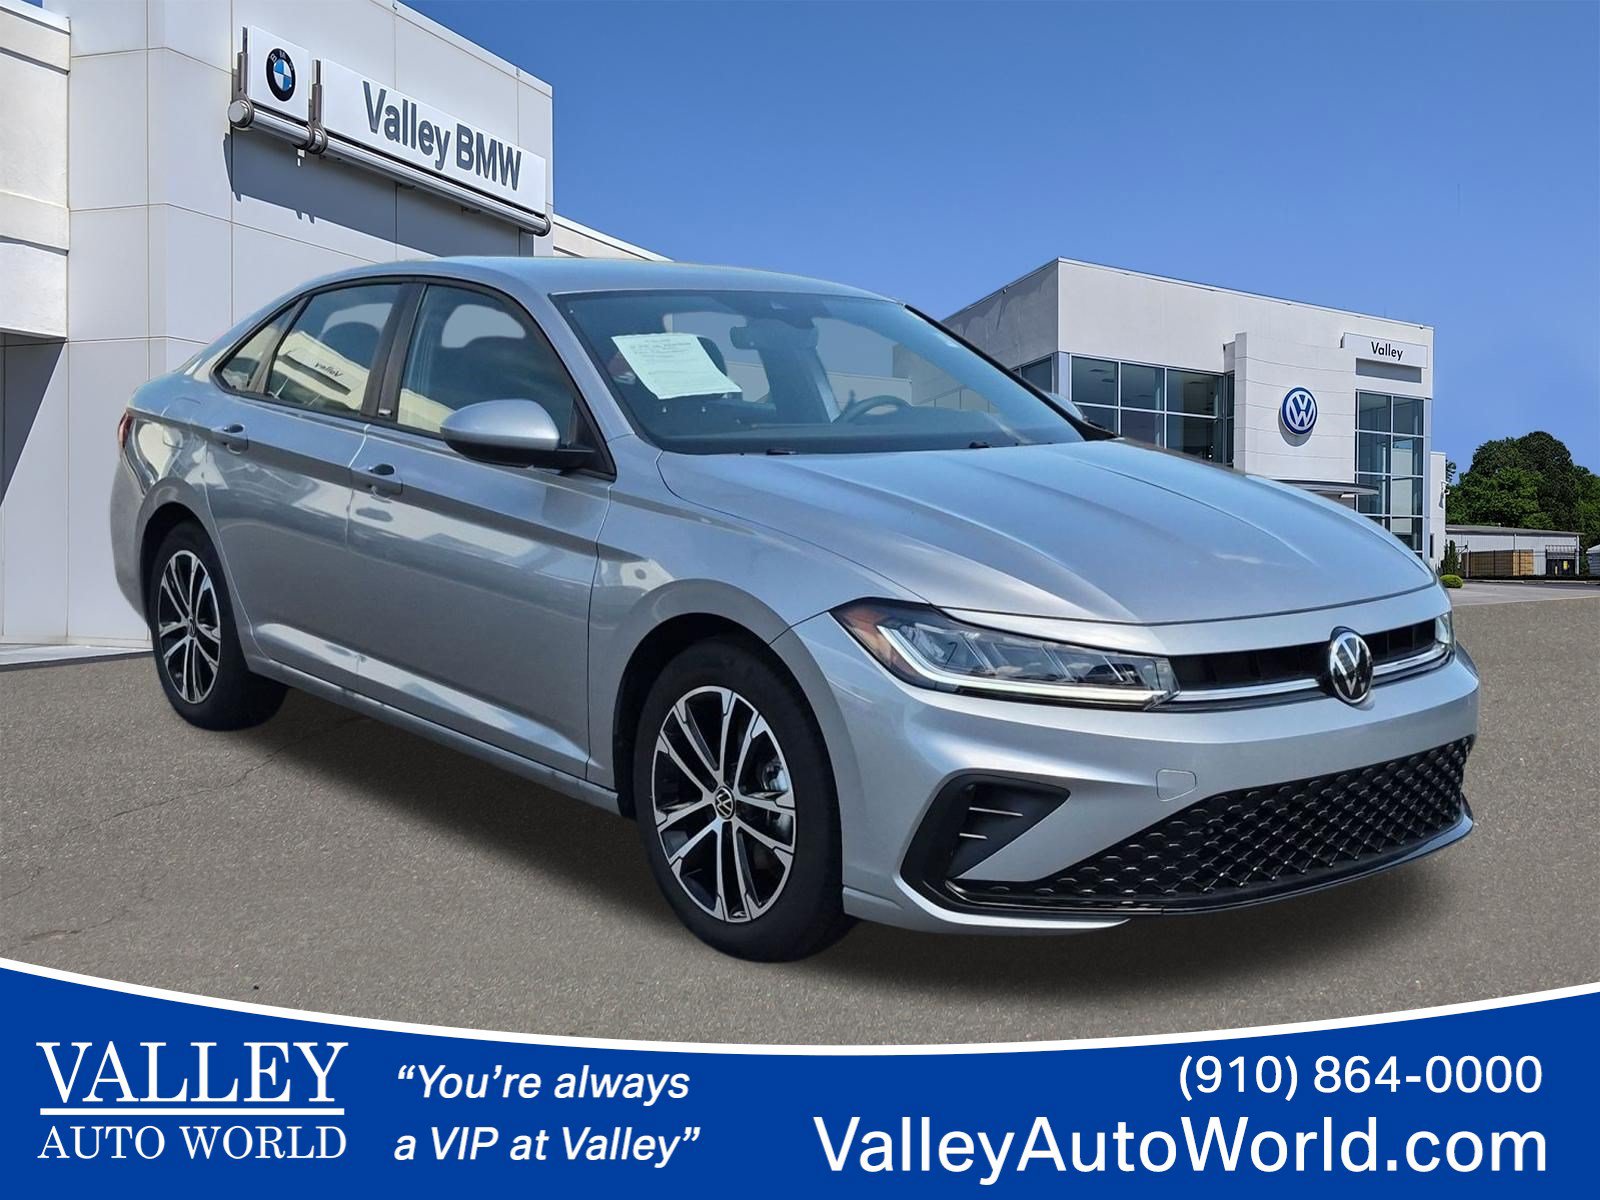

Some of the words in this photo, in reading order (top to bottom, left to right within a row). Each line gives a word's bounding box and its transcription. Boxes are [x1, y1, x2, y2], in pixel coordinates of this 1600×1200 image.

[362, 80, 451, 170] Valley
[456, 123, 522, 191] BMW
[1371, 341, 1404, 361] Valley
